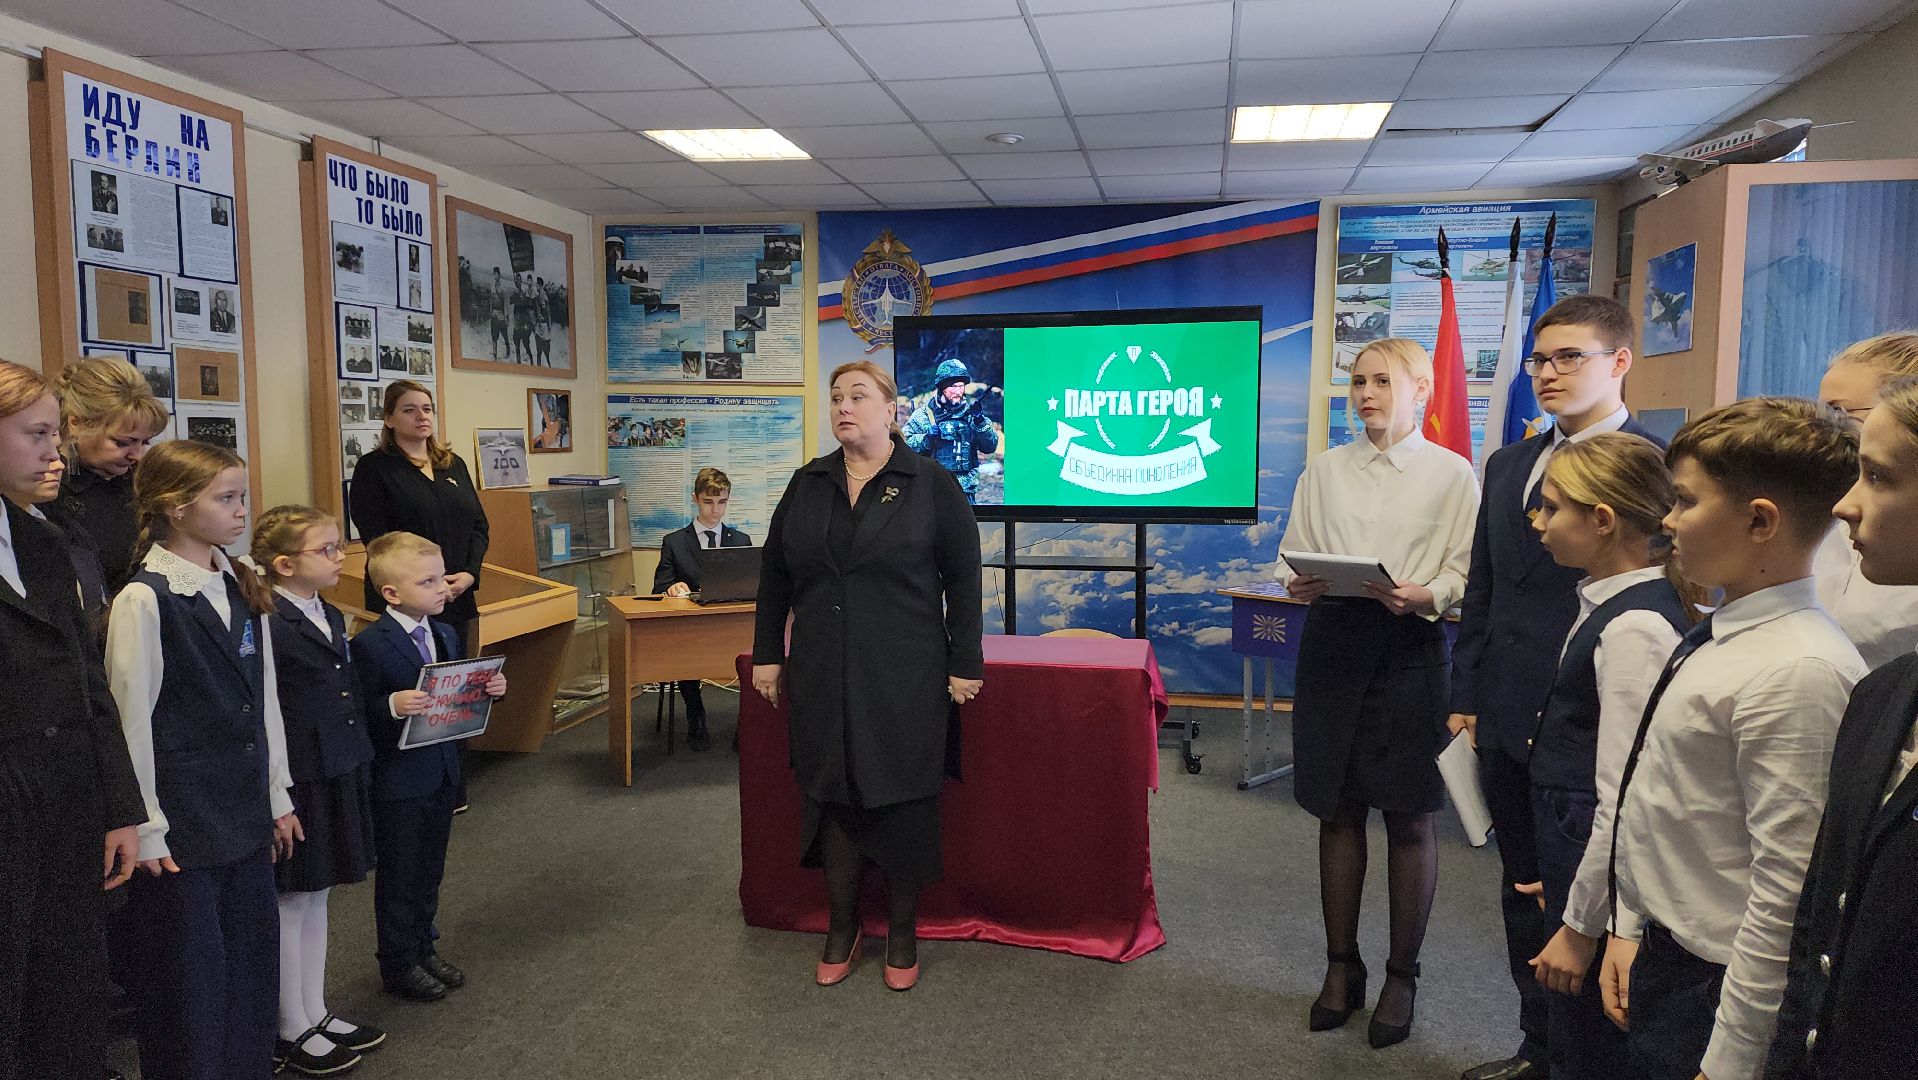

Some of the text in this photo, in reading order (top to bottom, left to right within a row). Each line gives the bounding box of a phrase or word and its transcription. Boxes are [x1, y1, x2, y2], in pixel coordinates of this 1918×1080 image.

[82, 83, 210, 151] ИДУ НА
[84, 123, 201, 184] БЕРЛИН
[328, 158, 409, 206] ЧТО БЫЛО
[355, 196, 423, 237] ТО БЫЛО
[1418, 205, 1512, 215] Армейская авиация
[714, 397, 742, 406] Родину
[742, 398, 780, 406] защищать
[1065, 386, 1204, 418] ПАРТА ГЕРОЯ
[441, 674, 461, 690] ПО
